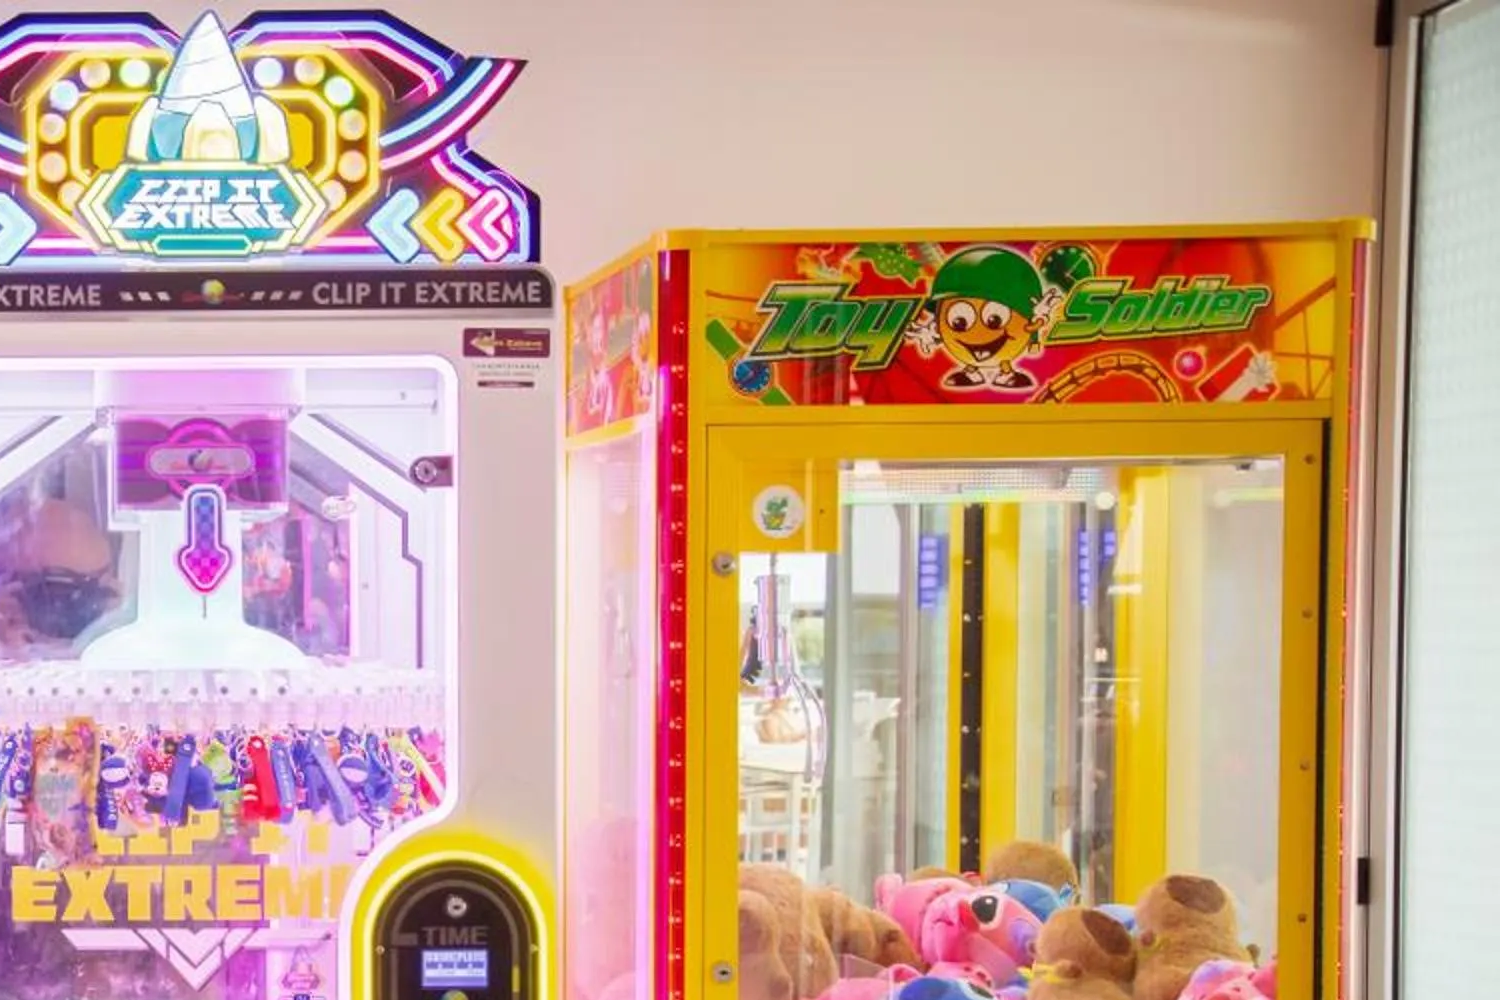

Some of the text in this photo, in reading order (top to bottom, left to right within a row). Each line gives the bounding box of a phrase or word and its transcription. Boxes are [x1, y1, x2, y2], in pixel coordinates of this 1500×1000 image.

[129, 178, 281, 204] CLIP IT
[110, 203, 296, 230] EXTREME
[312, 281, 370, 304] CLIP
[381, 281, 407, 304] IT
[415, 280, 542, 304] EXTREME
[752, 274, 1271, 370] Toy Soldier
[421, 926, 488, 947] TIME
